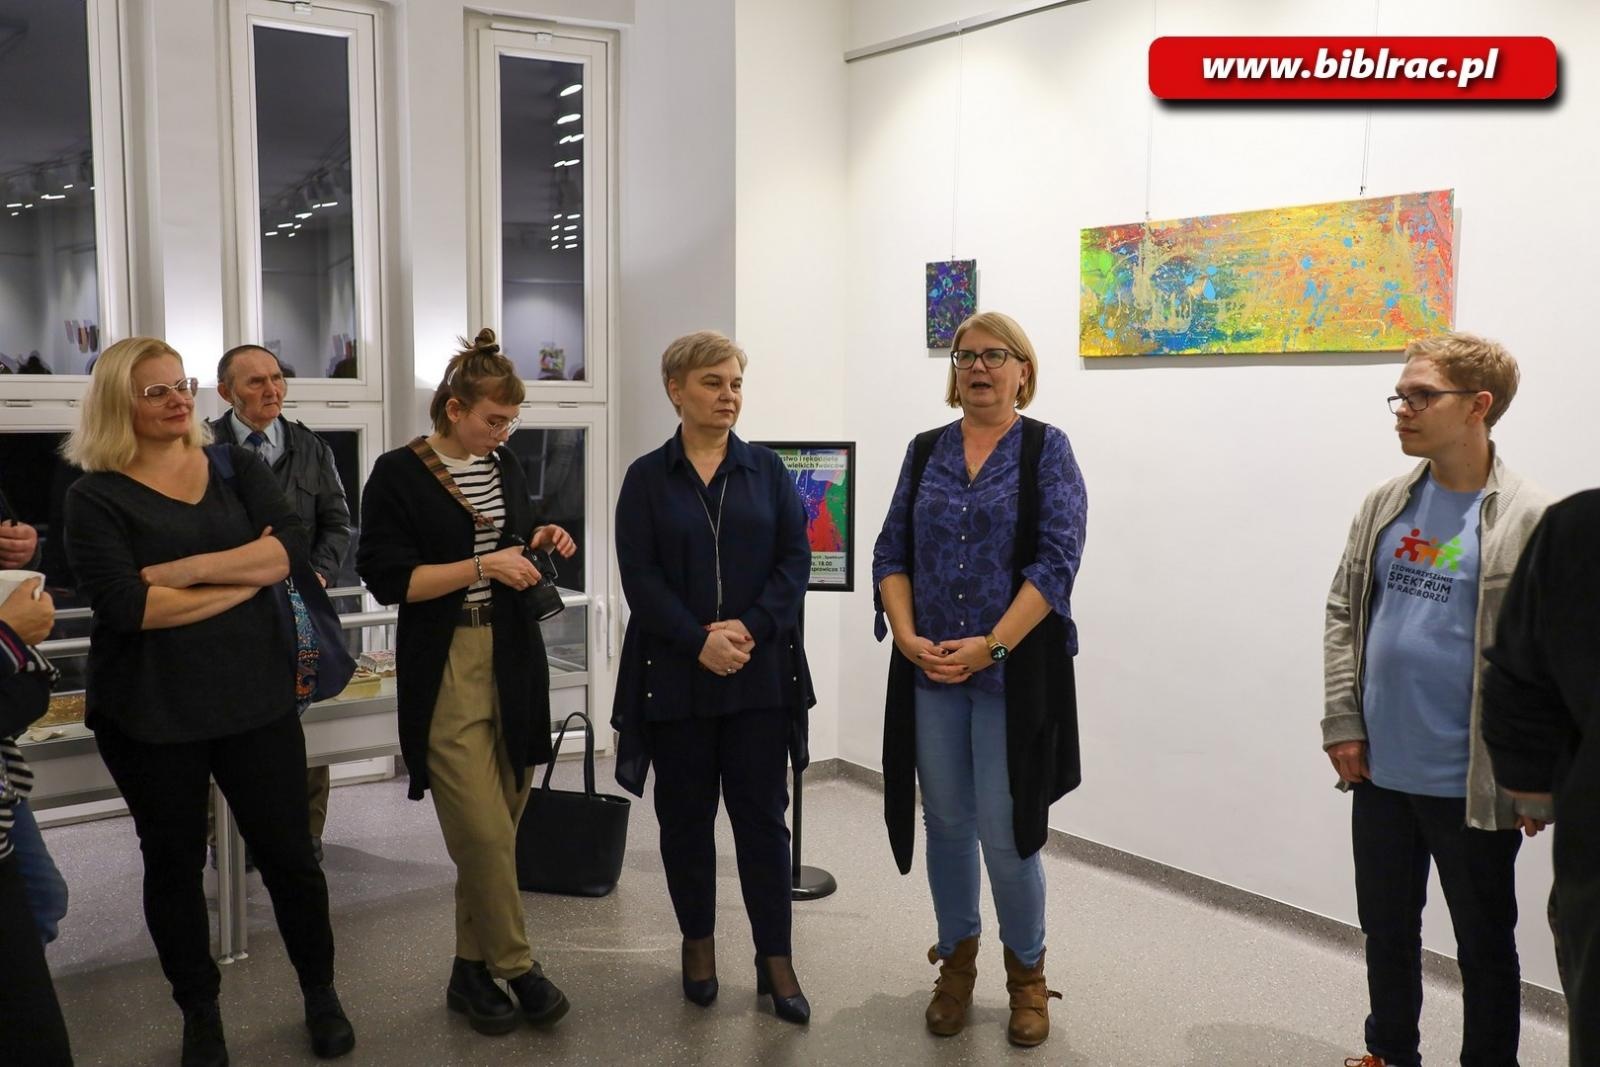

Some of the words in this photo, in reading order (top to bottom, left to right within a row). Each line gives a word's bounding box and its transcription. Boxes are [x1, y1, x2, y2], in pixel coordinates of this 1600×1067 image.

[1388, 571, 1452, 595] SPEKTRUM
[1391, 563, 1454, 583] STOWARZYSZENIE
[1387, 582, 1396, 590] W
[1397, 584, 1449, 603] RACIBORZU
